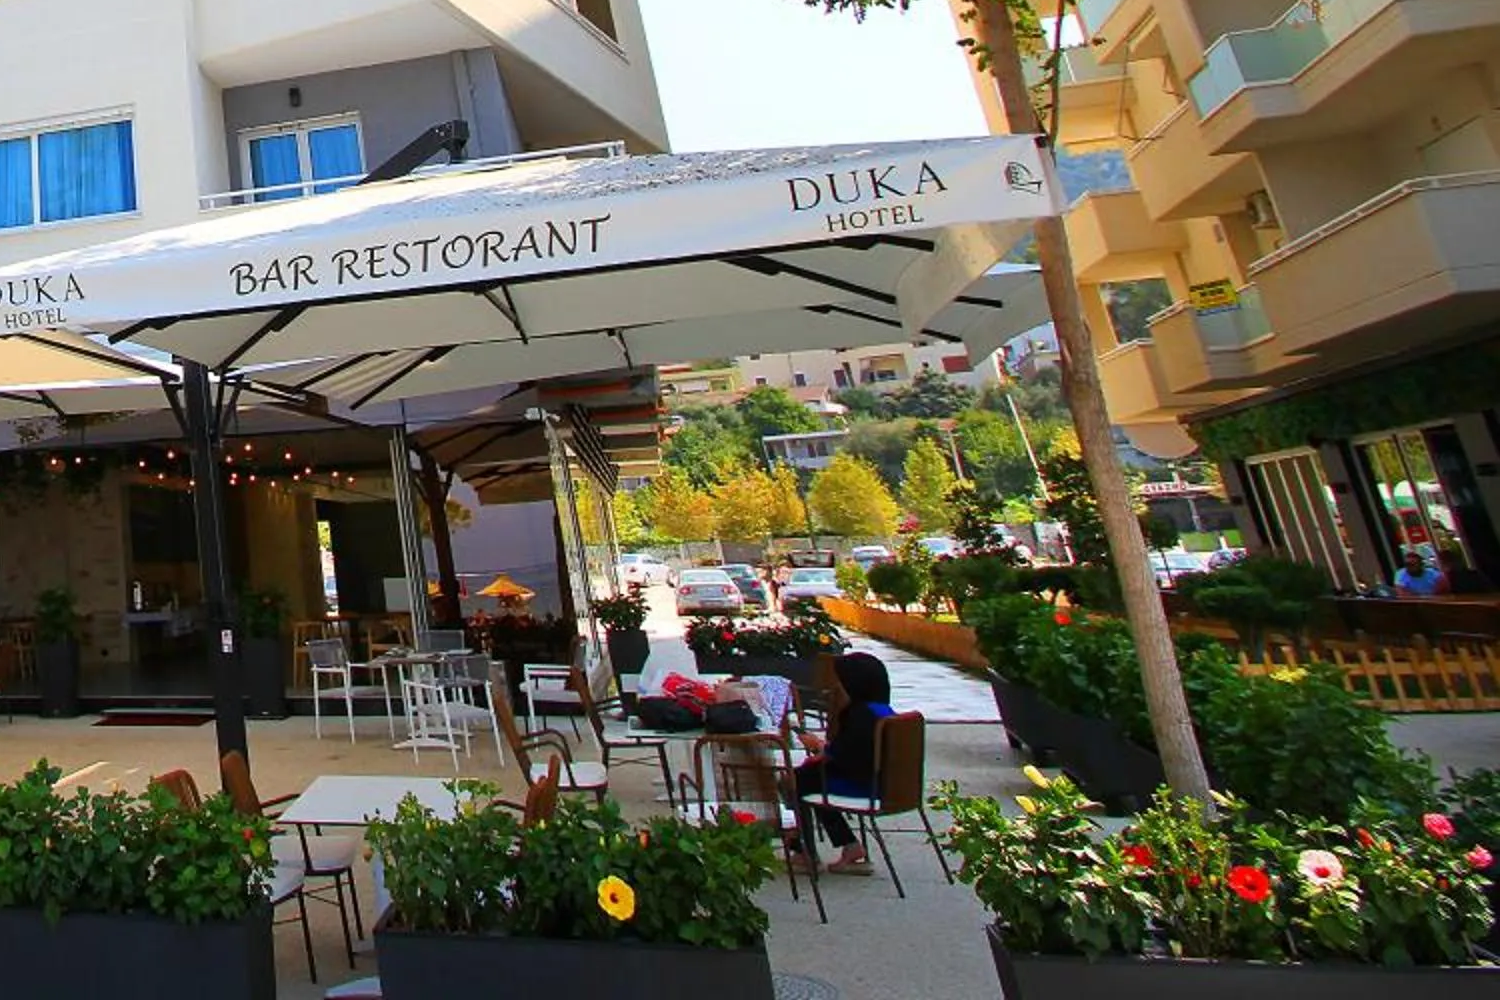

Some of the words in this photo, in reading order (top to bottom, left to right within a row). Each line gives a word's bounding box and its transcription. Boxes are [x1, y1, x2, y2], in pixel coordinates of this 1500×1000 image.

[786, 161, 948, 212] DUKA
[826, 204, 925, 233] HOTEL
[229, 255, 319, 296] BAR
[332, 213, 612, 286] RESTORANT
[4, 307, 67, 329] HOTEL
